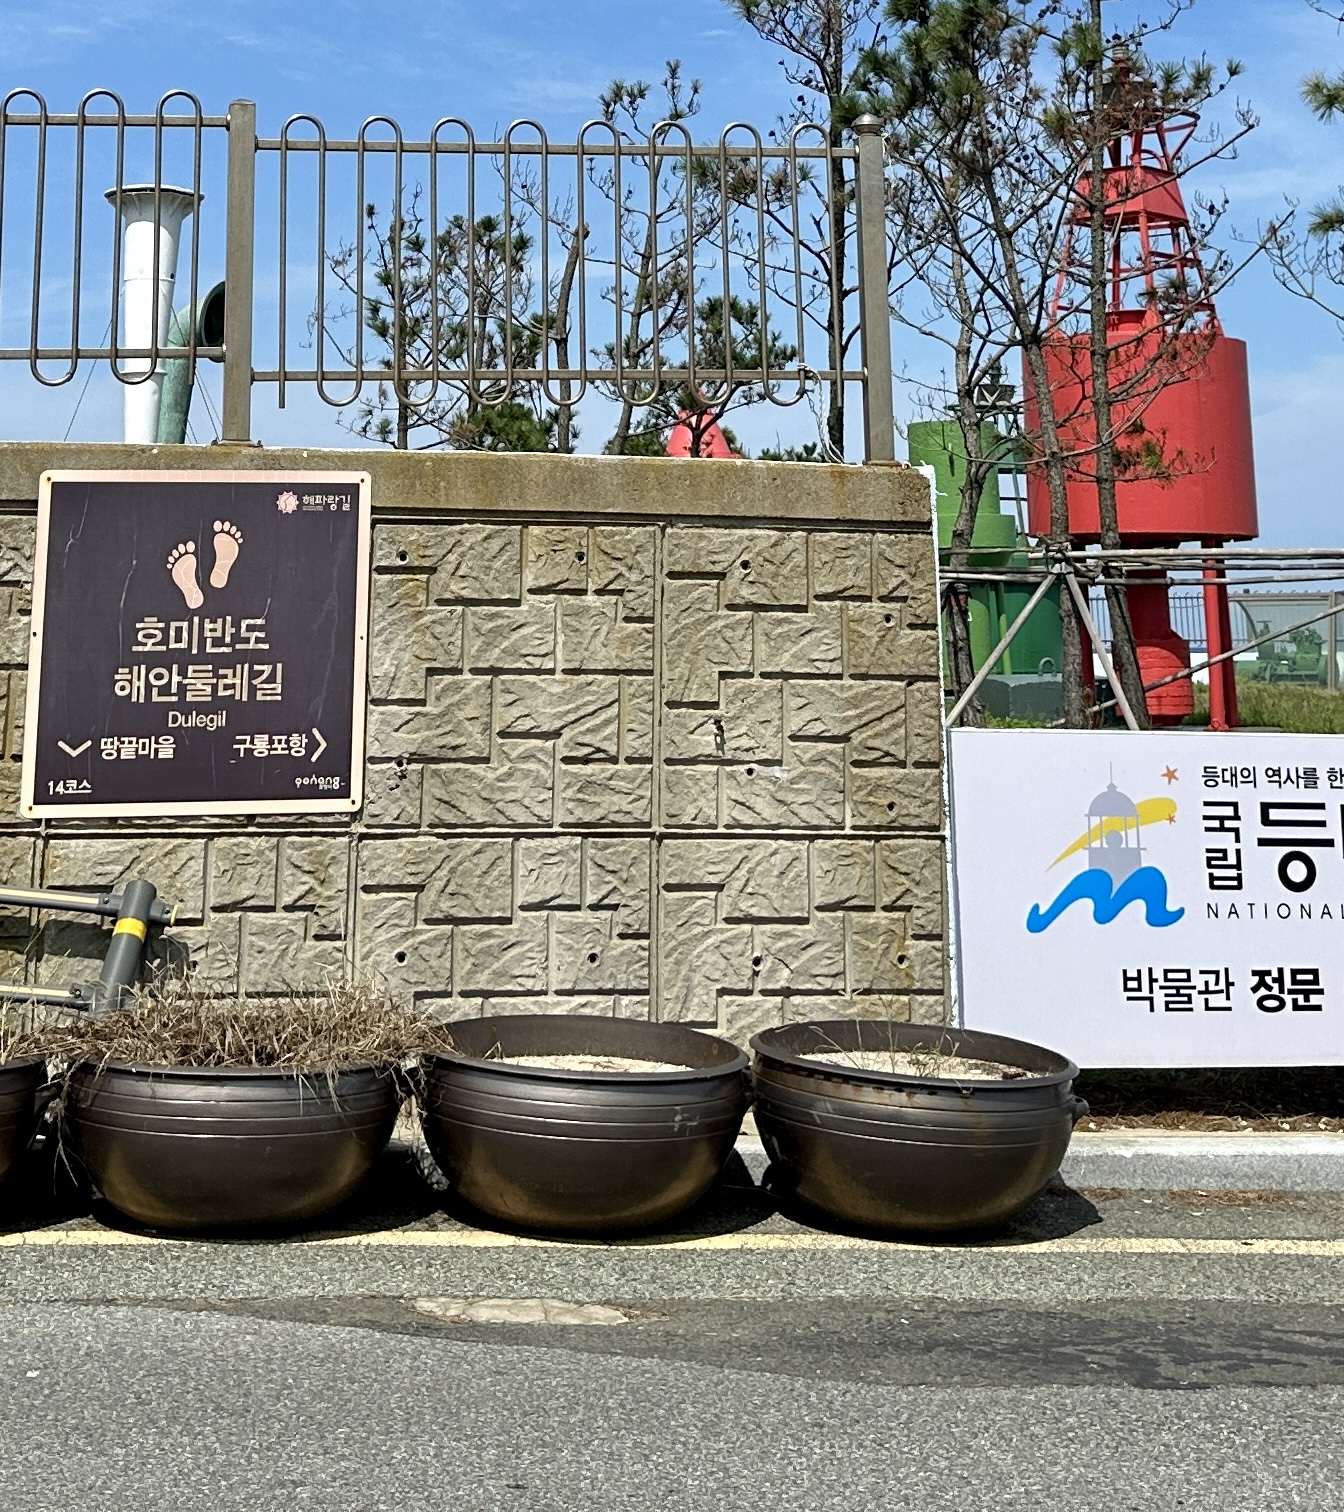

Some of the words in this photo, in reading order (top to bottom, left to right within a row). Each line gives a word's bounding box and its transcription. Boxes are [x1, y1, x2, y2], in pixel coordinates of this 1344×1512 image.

[301, 494, 351, 511] 해파랑길
[131, 616, 270, 655] 호미반도
[114, 662, 283, 704] 해안둘레길
[167, 710, 227, 731] Dulegil
[100, 735, 177, 760] 땅끝마을
[232, 733, 309, 758] 구룡포항
[47, 779, 93, 796] 14코스
[1201, 765, 1257, 789] 등대의
[1264, 766, 1320, 790] 역사를
[1202, 800, 1244, 891] 국립
[1122, 966, 1236, 1013] 박물관
[1250, 966, 1325, 1014] 정문
